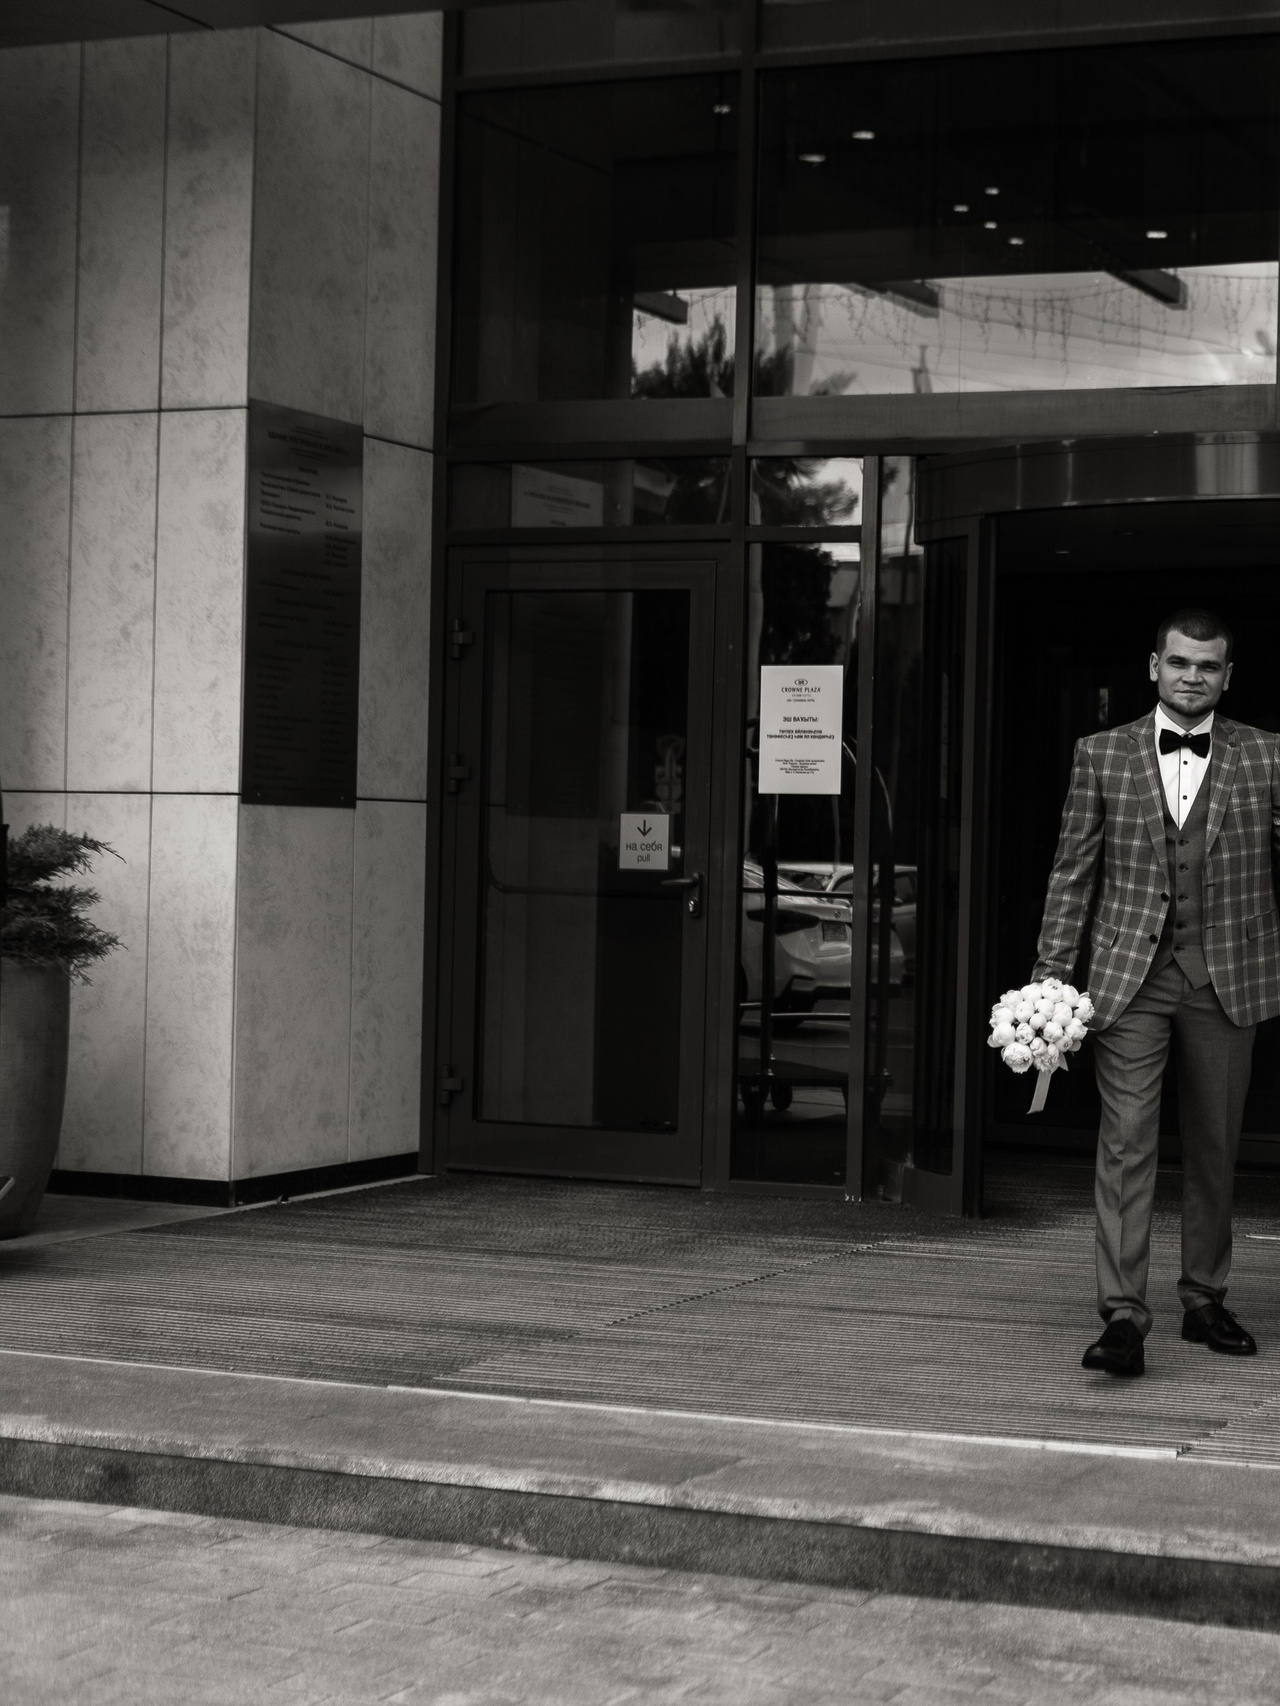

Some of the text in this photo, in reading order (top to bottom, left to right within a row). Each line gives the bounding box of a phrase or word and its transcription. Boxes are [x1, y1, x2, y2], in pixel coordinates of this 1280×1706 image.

[625, 841, 663, 851] на себя
[637, 853, 650, 864] pull
